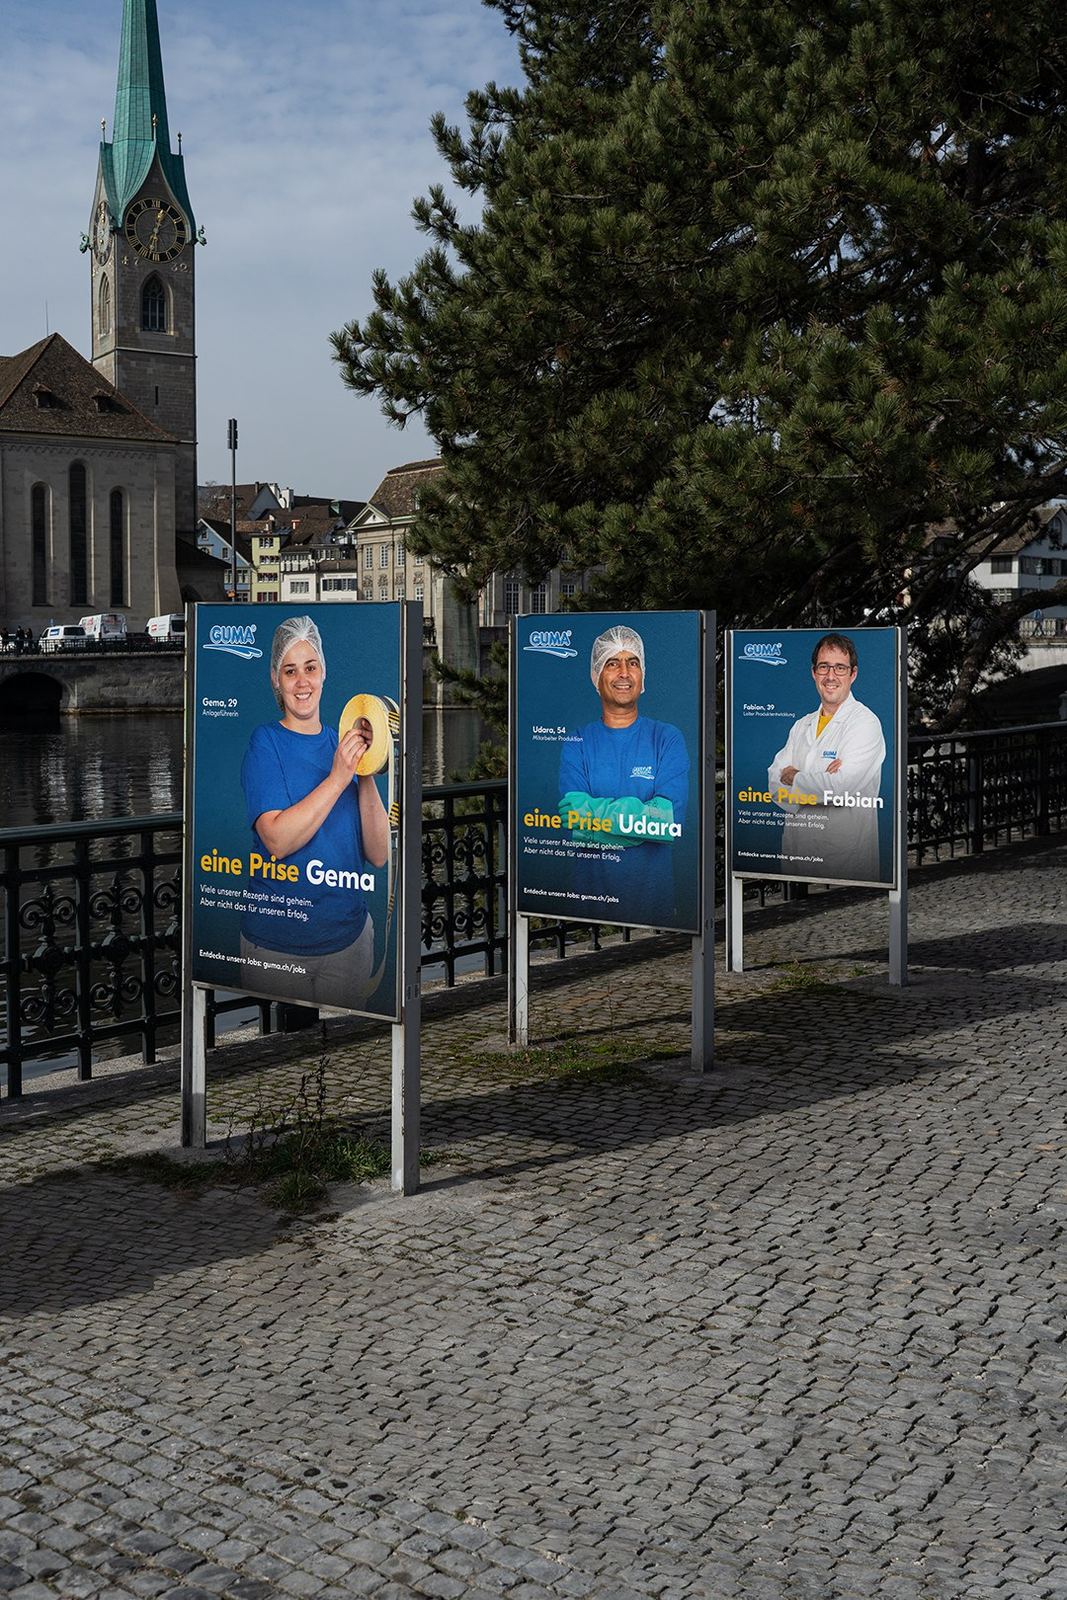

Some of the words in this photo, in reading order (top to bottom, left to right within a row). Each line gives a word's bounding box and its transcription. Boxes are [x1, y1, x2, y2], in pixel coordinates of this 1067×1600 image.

[202, 697, 227, 708] Gema,
[228, 698, 238, 707] 29
[532, 726, 556, 735] Udara,
[557, 726, 566, 734] 54
[738, 787, 772, 803] eine
[777, 787, 817, 806] Prise
[823, 790, 884, 808] Fabian
[523, 808, 562, 829] eine
[567, 808, 613, 832] Prise
[619, 814, 682, 837] Udara
[200, 848, 243, 876] eine
[250, 853, 299, 882] Prise
[306, 859, 375, 892] Gema
[200, 884, 216, 895] Viele
[217, 888, 241, 898] unserer
[242, 890, 269, 902] Rezepte
[270, 894, 284, 904] sind
[286, 896, 313, 908] geheim.
[200, 897, 216, 907] Aber
[217, 899, 233, 910] nicht
[234, 902, 247, 911] das
[248, 903, 257, 913] für
[259, 907, 286, 917] unseren
[287, 909, 309, 921] Erfolg.
[200, 950, 226, 961] Entdecke
[226, 955, 247, 964] unsere
[247, 957, 263, 967] Jobs:
[263, 961, 306, 974] guma.ch/jobs
